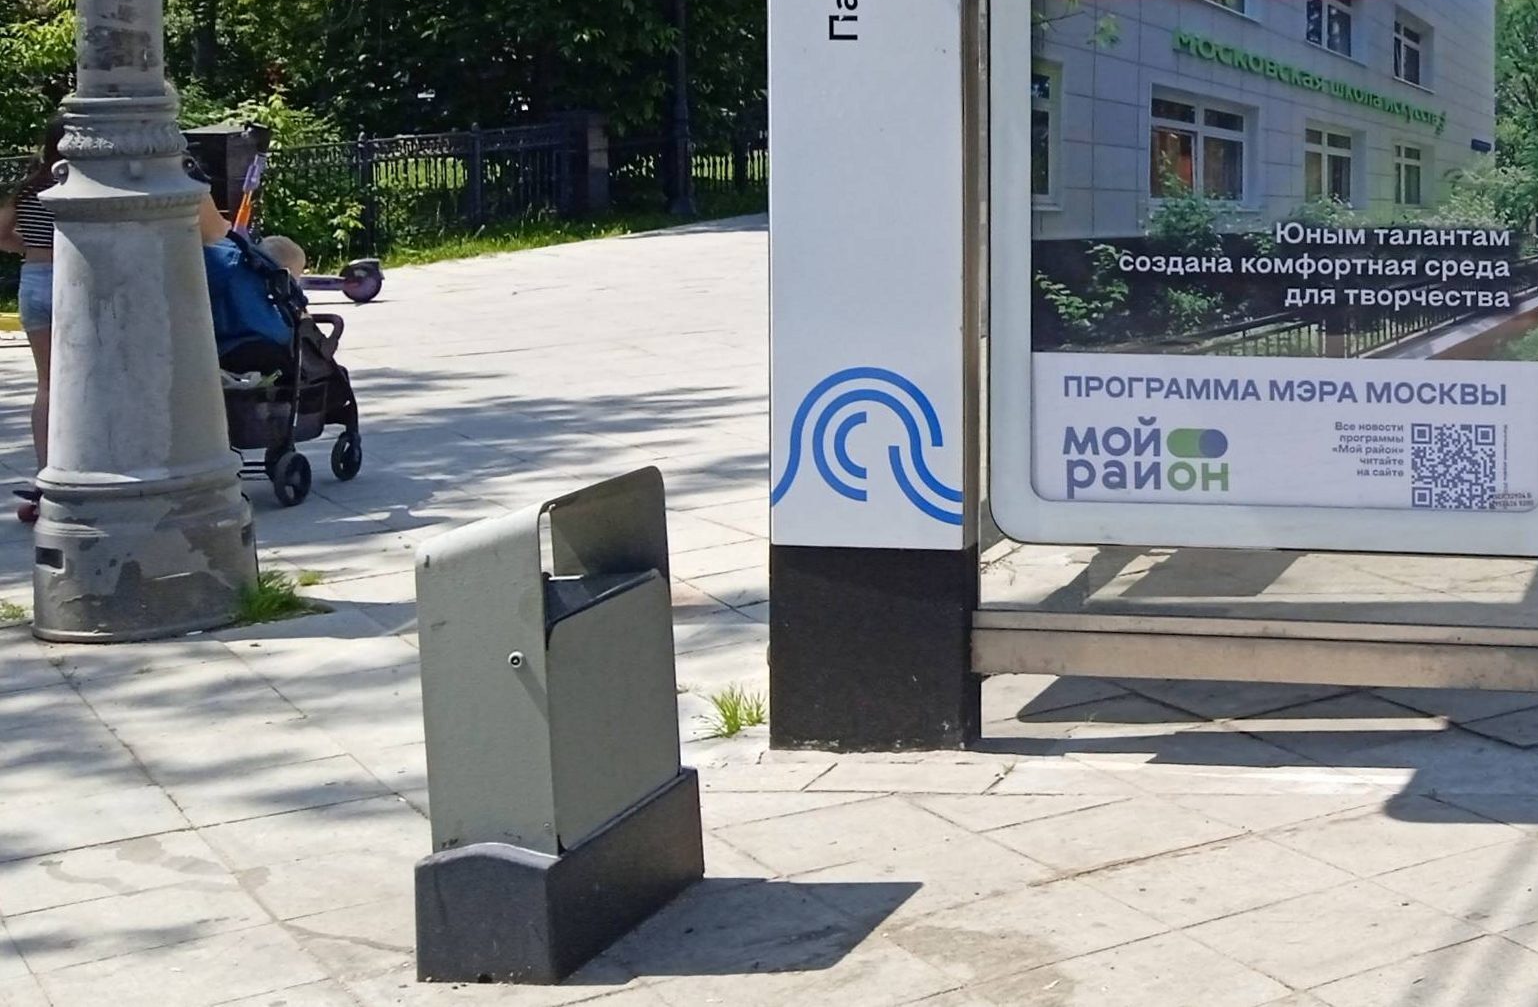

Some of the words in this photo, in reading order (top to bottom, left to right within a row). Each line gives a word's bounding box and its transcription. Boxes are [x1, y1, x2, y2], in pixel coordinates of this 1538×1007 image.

[1276, 222, 1366, 245] Юным
[1374, 227, 1510, 246] талантам
[1119, 255, 1233, 274] создана
[1241, 253, 1417, 280] комфортная
[1424, 261, 1510, 282] среда
[1284, 286, 1336, 307] для
[1344, 288, 1510, 311] творчества
[1064, 375, 1262, 401] ПРОГРАММА
[1269, 380, 1358, 403] МЭРА
[1366, 381, 1507, 406] МОСКВЫ
[1063, 416, 1161, 457] мой
[1334, 422, 1355, 431] Все
[1359, 423, 1404, 432] новости
[1339, 434, 1404, 444] программы
[1357, 469, 1370, 477] на
[1373, 467, 1404, 477] сайте
[1360, 456, 1404, 466] читайте
